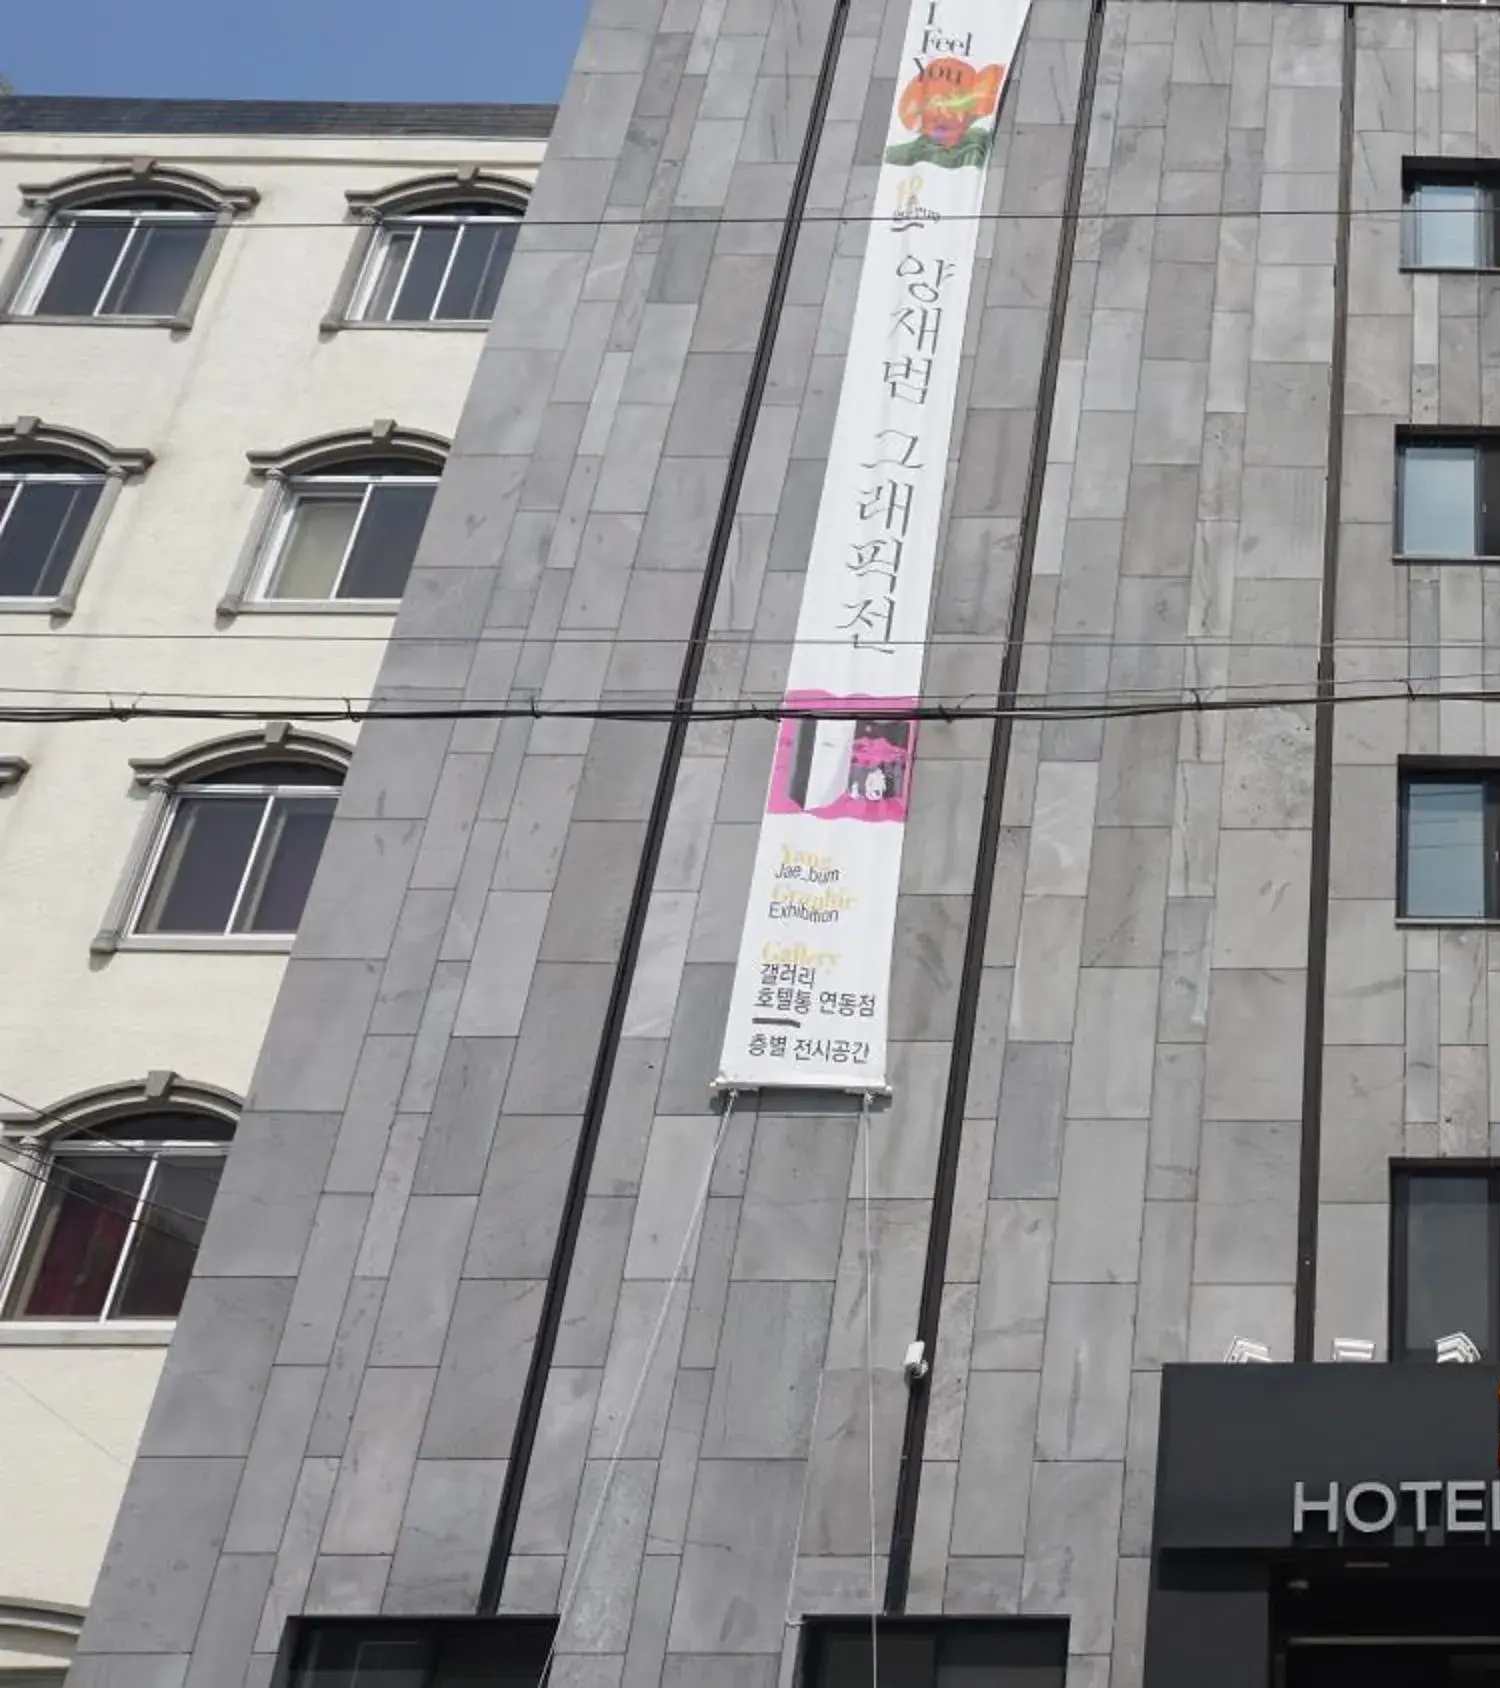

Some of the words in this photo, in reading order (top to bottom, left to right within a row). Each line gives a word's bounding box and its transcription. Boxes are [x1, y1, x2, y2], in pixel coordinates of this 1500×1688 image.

[921, 27, 973, 57] Feel
[912, 57, 963, 85] You
[881, 254, 956, 405] 양재범
[835, 428, 925, 656] 그래픽전
[767, 900, 840, 924] Exhibition
[759, 963, 816, 990] 갤러리
[752, 987, 812, 1015] 호텔통
[819, 991, 876, 1018] 연동점
[748, 1033, 787, 1058] 층별
[793, 1039, 870, 1065] 전시공간
